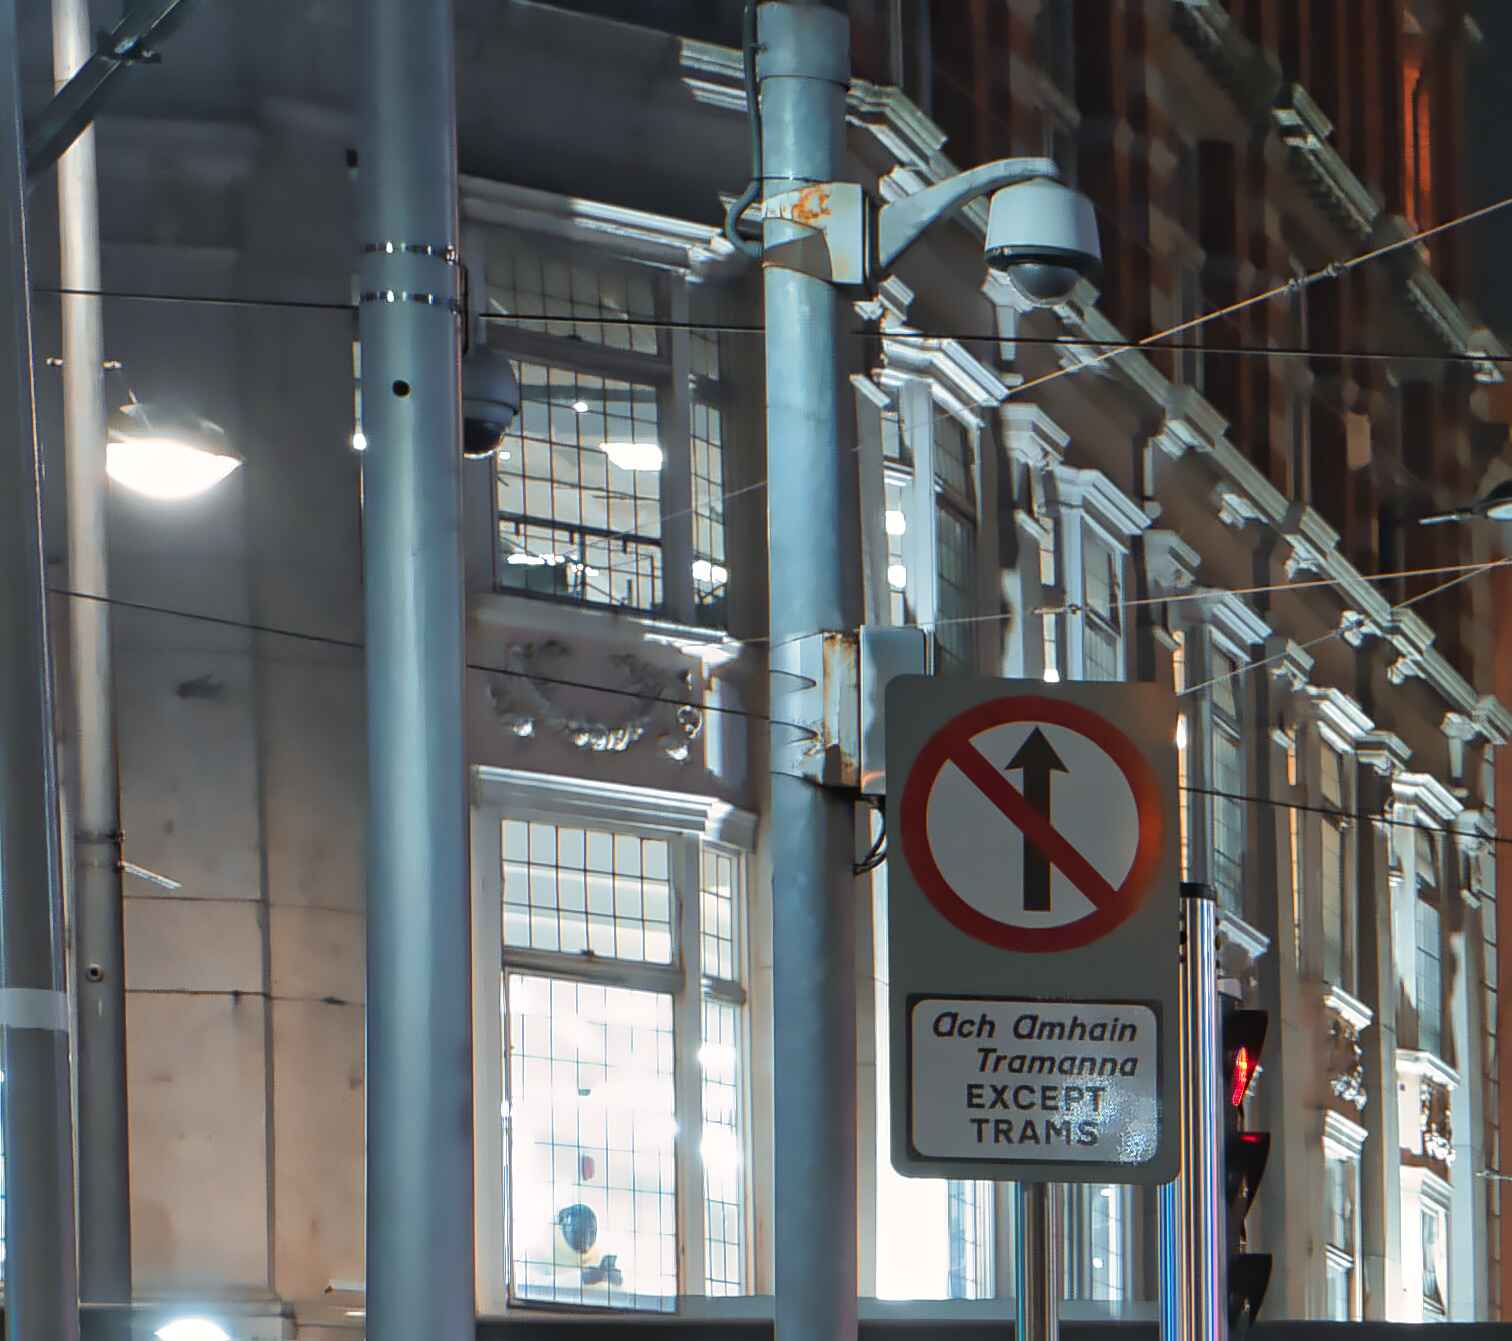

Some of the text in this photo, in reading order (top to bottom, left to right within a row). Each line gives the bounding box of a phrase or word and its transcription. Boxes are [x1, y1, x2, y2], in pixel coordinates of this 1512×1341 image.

[932, 1011, 996, 1039] Ach
[976, 1047, 1139, 1077] Tramanna
[966, 1083, 1106, 1113] EXCEPT
[969, 1117, 1099, 1147] TRAMS
